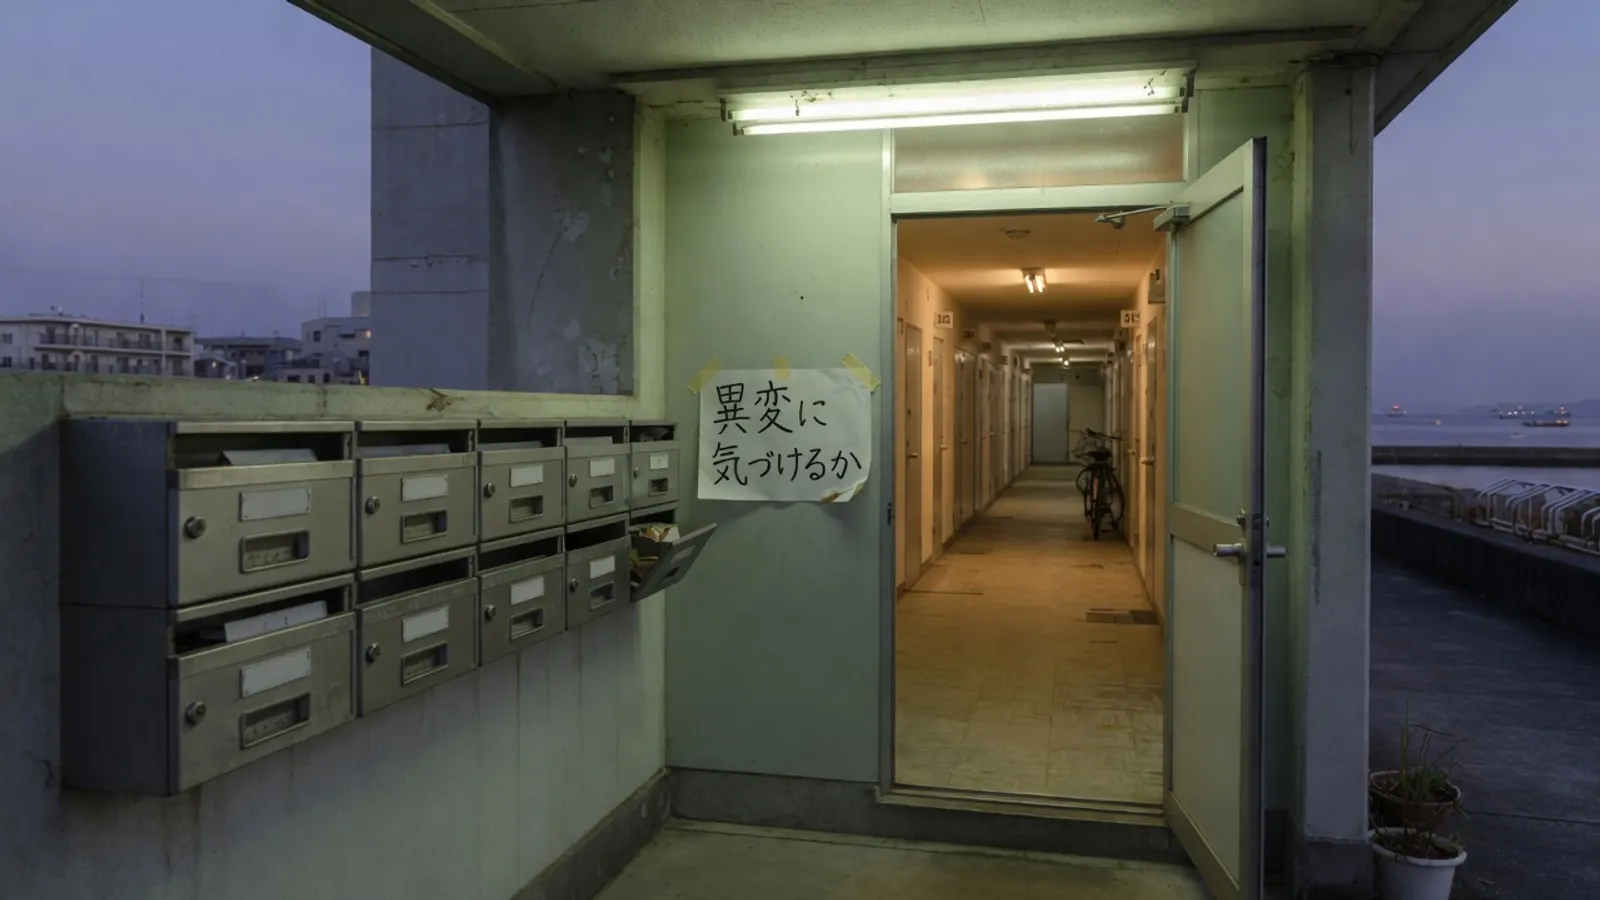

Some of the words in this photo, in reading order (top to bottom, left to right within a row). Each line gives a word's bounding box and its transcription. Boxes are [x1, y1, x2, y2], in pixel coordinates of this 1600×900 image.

[713, 380, 827, 435] 異変に
[712, 442, 862, 486] 気づけるか
